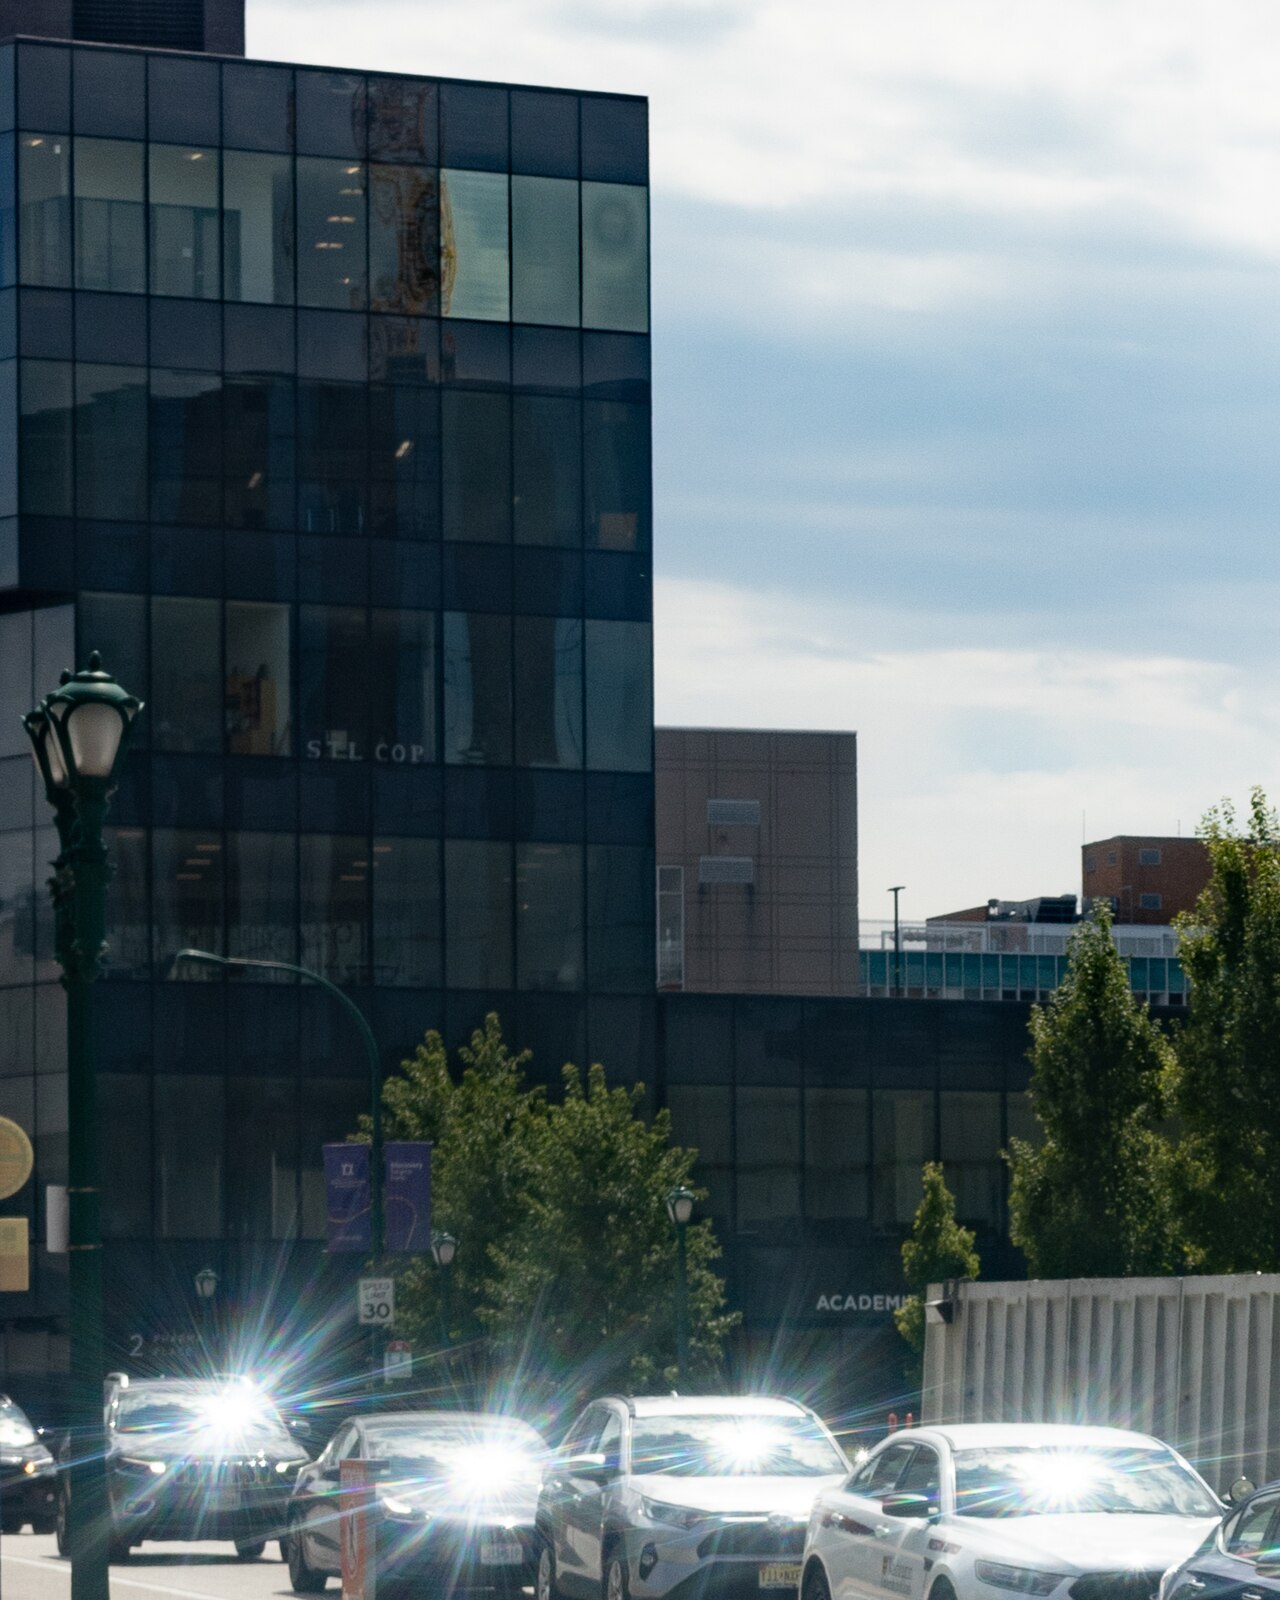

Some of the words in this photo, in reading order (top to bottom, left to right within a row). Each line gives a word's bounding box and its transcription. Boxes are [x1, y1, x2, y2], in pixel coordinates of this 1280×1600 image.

[375, 743, 425, 764] COP
[362, 1282, 390, 1291] SPEED
[363, 1302, 391, 1319] 30
[128, 1334, 144, 1357] 2
